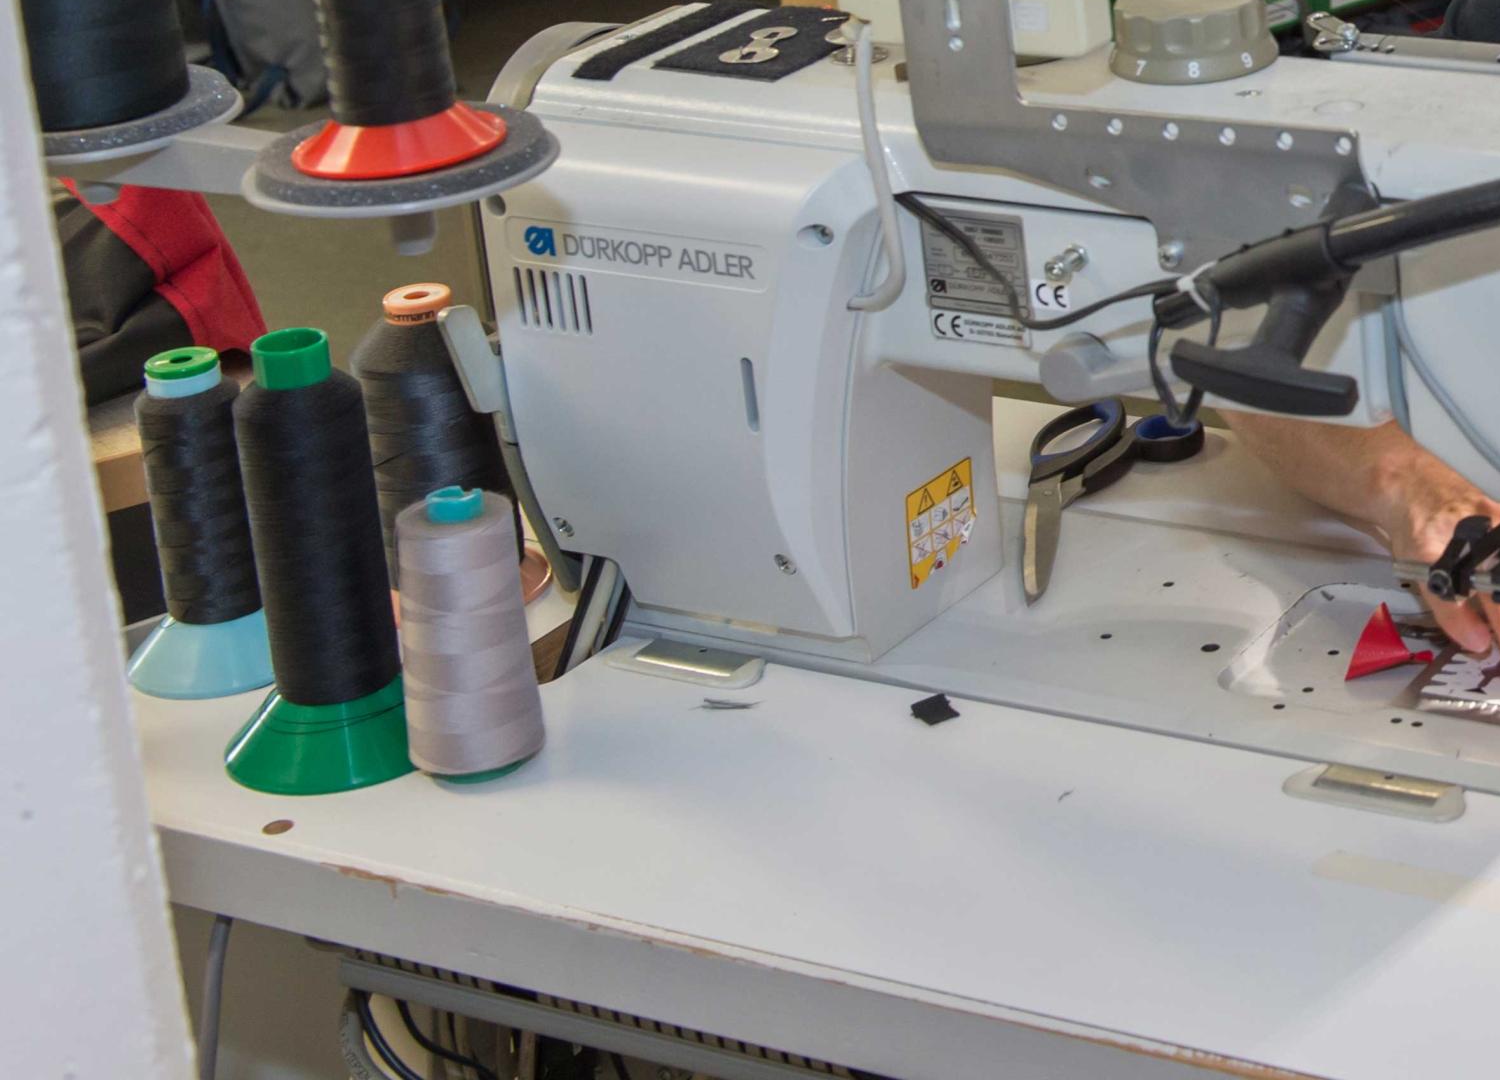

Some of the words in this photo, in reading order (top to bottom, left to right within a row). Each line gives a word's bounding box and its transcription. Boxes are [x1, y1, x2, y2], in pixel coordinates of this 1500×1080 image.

[1135, 59, 1147, 76] 7
[1187, 61, 1200, 79] 8
[1241, 52, 1253, 69] 9
[562, 233, 672, 268] DÜRKOPP
[678, 248, 756, 280] ADLER
[1035, 283, 1067, 308] CE
[934, 313, 964, 338] CE
